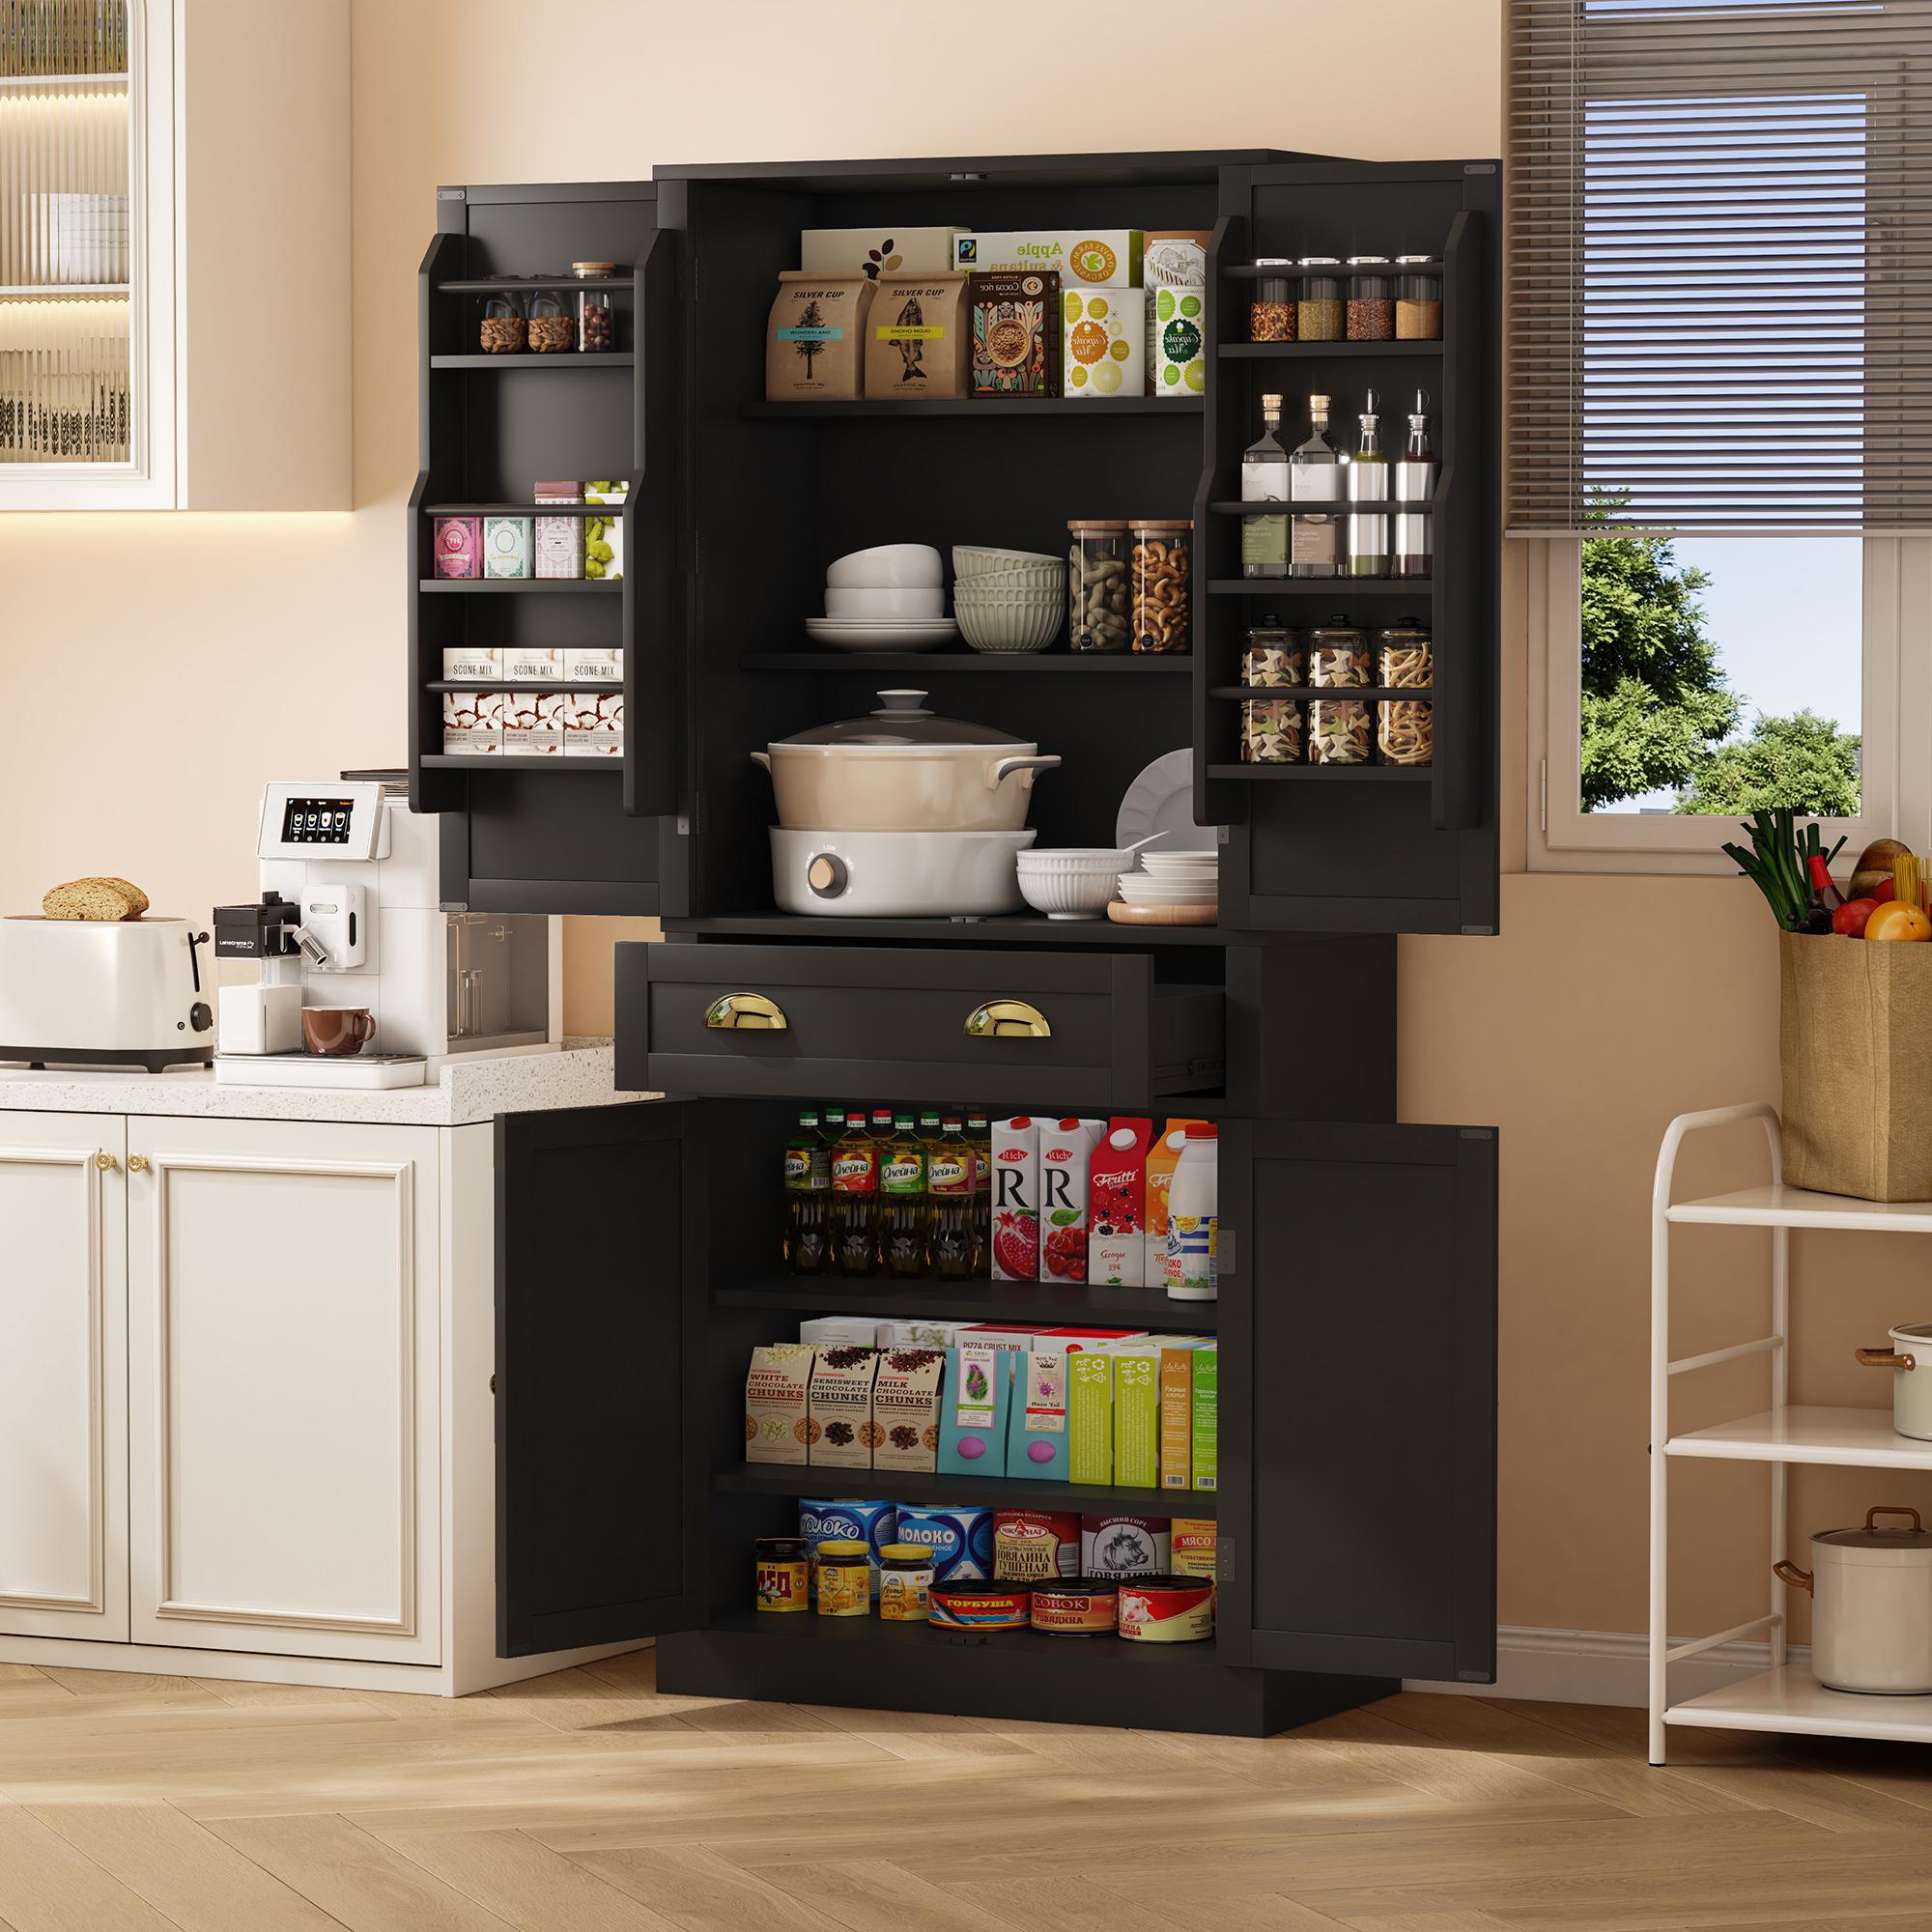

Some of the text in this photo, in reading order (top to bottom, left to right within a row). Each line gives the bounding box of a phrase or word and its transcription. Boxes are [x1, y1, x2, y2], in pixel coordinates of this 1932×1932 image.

[453, 665, 493, 675] SCONE MIX
[514, 665, 554, 675] SCONE MIX
[574, 666, 614, 676] SCONE MIX
[1003, 1151, 1024, 1160] Rich
[1049, 1151, 1069, 1160] Rich
[835, 1162, 869, 1175] Олейна
[884, 1165, 919, 1179] Олейна
[928, 1165, 960, 1179] Олейна
[1093, 1170, 1137, 1187] Frutti
[995, 1168, 1029, 1208] R
[1043, 1168, 1075, 1208] R
[984, 1343, 1007, 1351] CRUST
[748, 1388, 804, 1398] CHUNKS
[812, 1384, 869, 1393] CHOCOLATE
[811, 1392, 867, 1401] CHUNKS
[876, 1395, 932, 1405] CHUNKS
[1100, 1517, 1147, 1527] ВЫСШИЙ СОРТ
[898, 1526, 955, 1544] МОЛОКО
[1182, 1537, 1211, 1547] МЯСО
[998, 1549, 1051, 1563] ГОВЯДИНА
[1000, 1560, 1048, 1573] ТУШЕНАЯ
[947, 1599, 1014, 1608] ГОРБУША
[1036, 1597, 1086, 1609] СОВОК
[1036, 1614, 1084, 1624] ГОВЯДИНА
